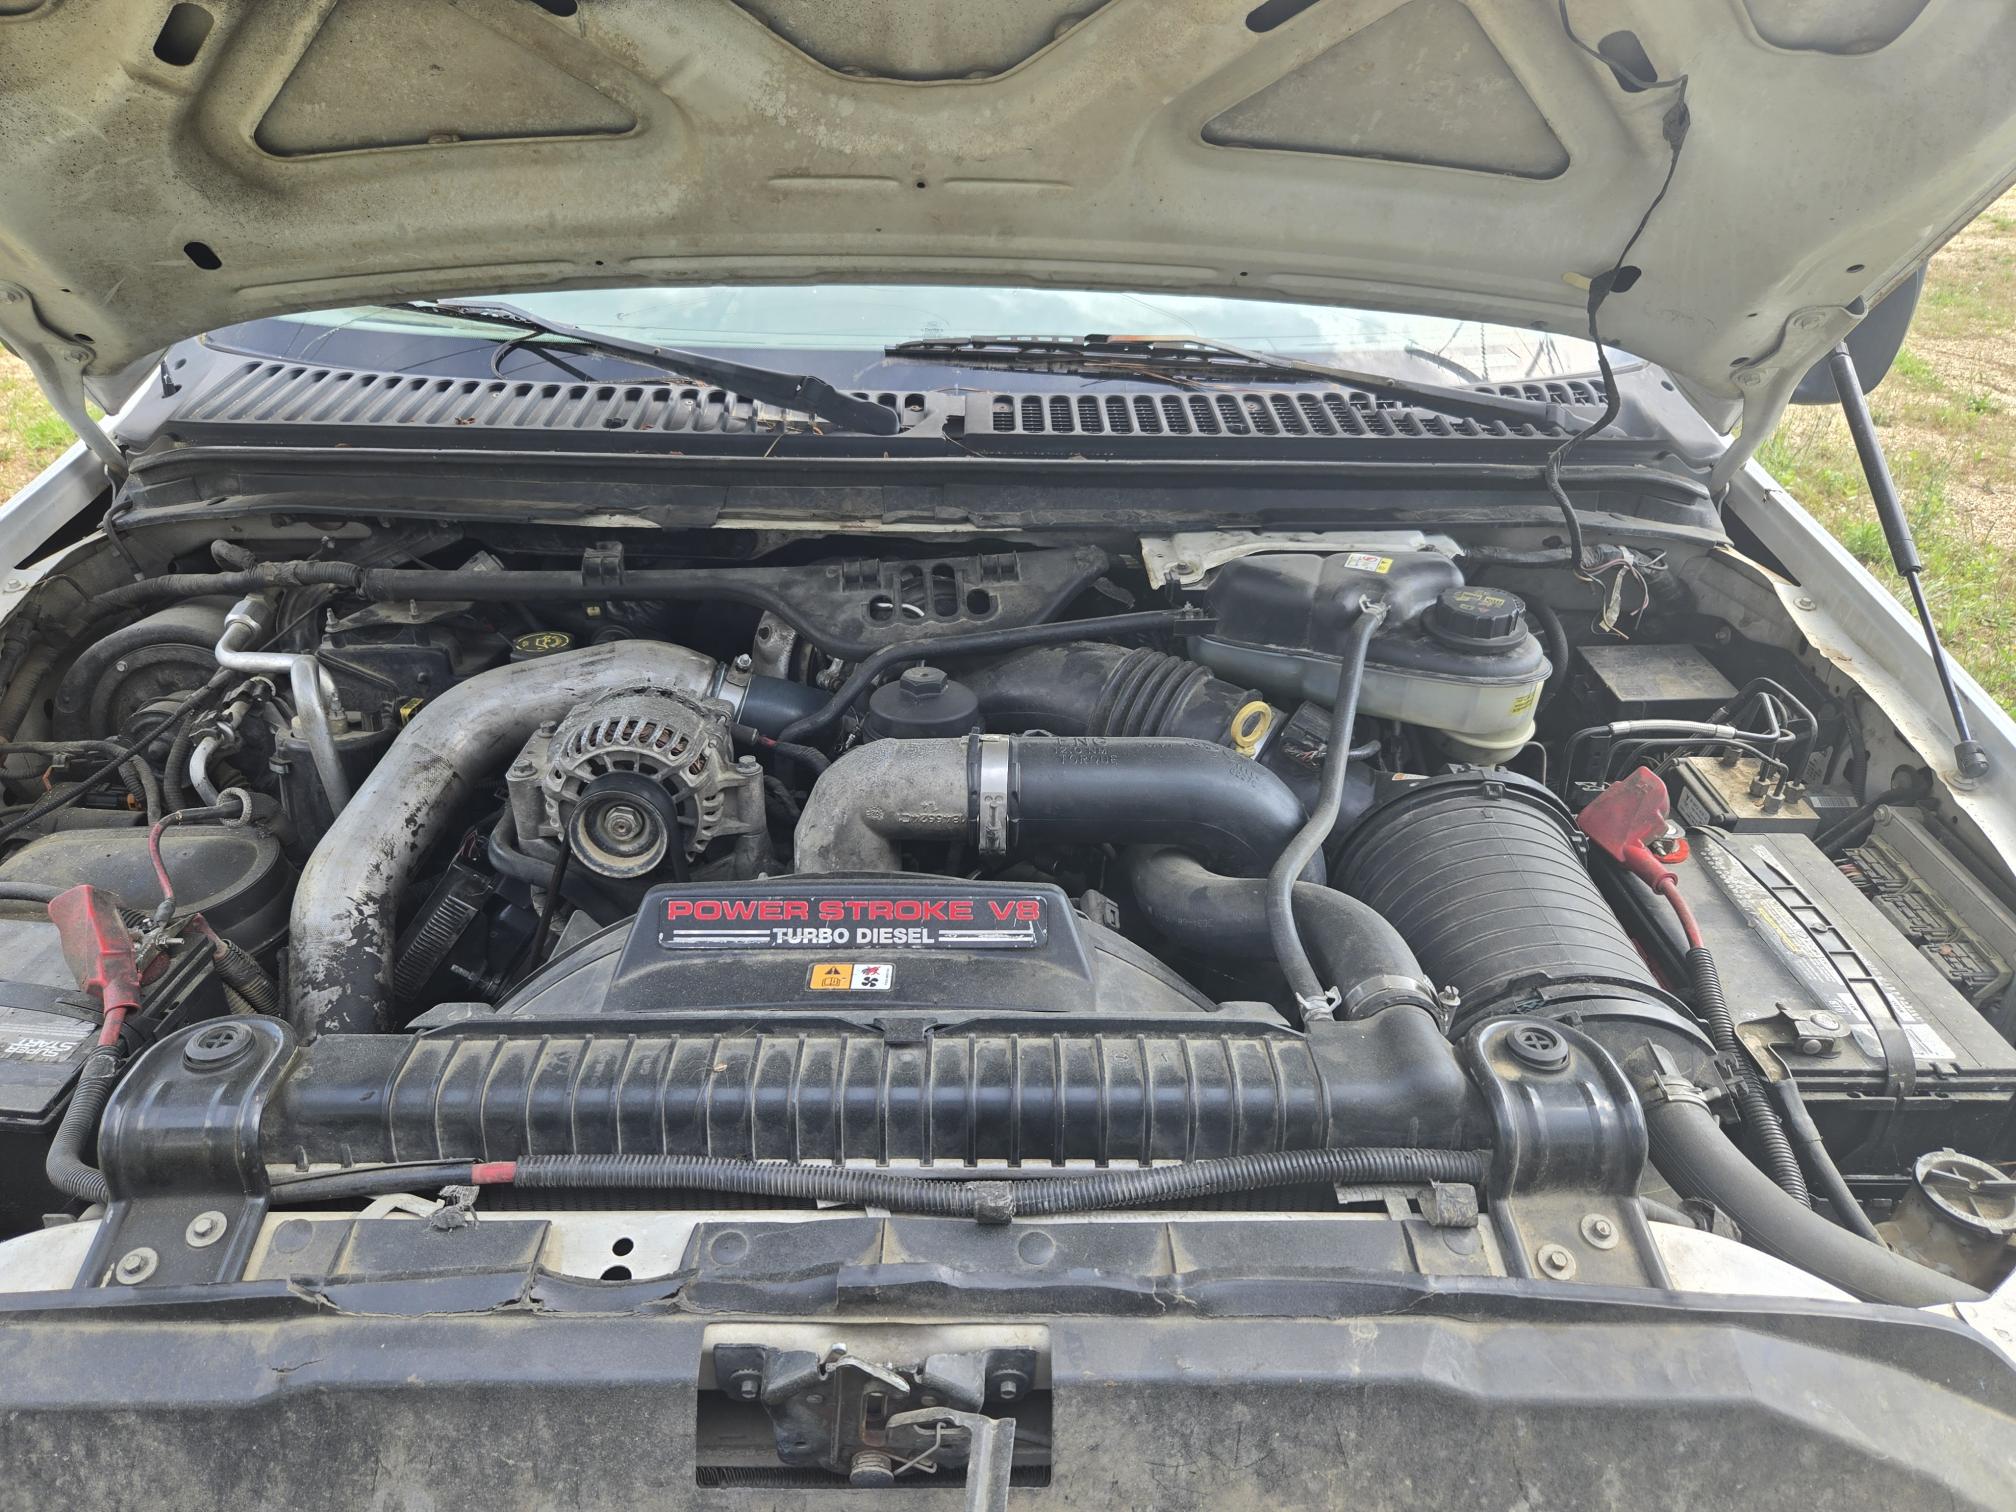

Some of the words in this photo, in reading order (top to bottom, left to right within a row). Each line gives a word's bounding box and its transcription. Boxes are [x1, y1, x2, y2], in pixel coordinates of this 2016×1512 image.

[667, 900, 809, 921] POWER
[818, 900, 974, 921] STROKE
[987, 900, 1041, 921] V8
[772, 927, 850, 944] TURBO
[856, 927, 935, 944] DIESEL
[4, 1045, 59, 1057] SUPER
[10, 1037, 78, 1052] START
